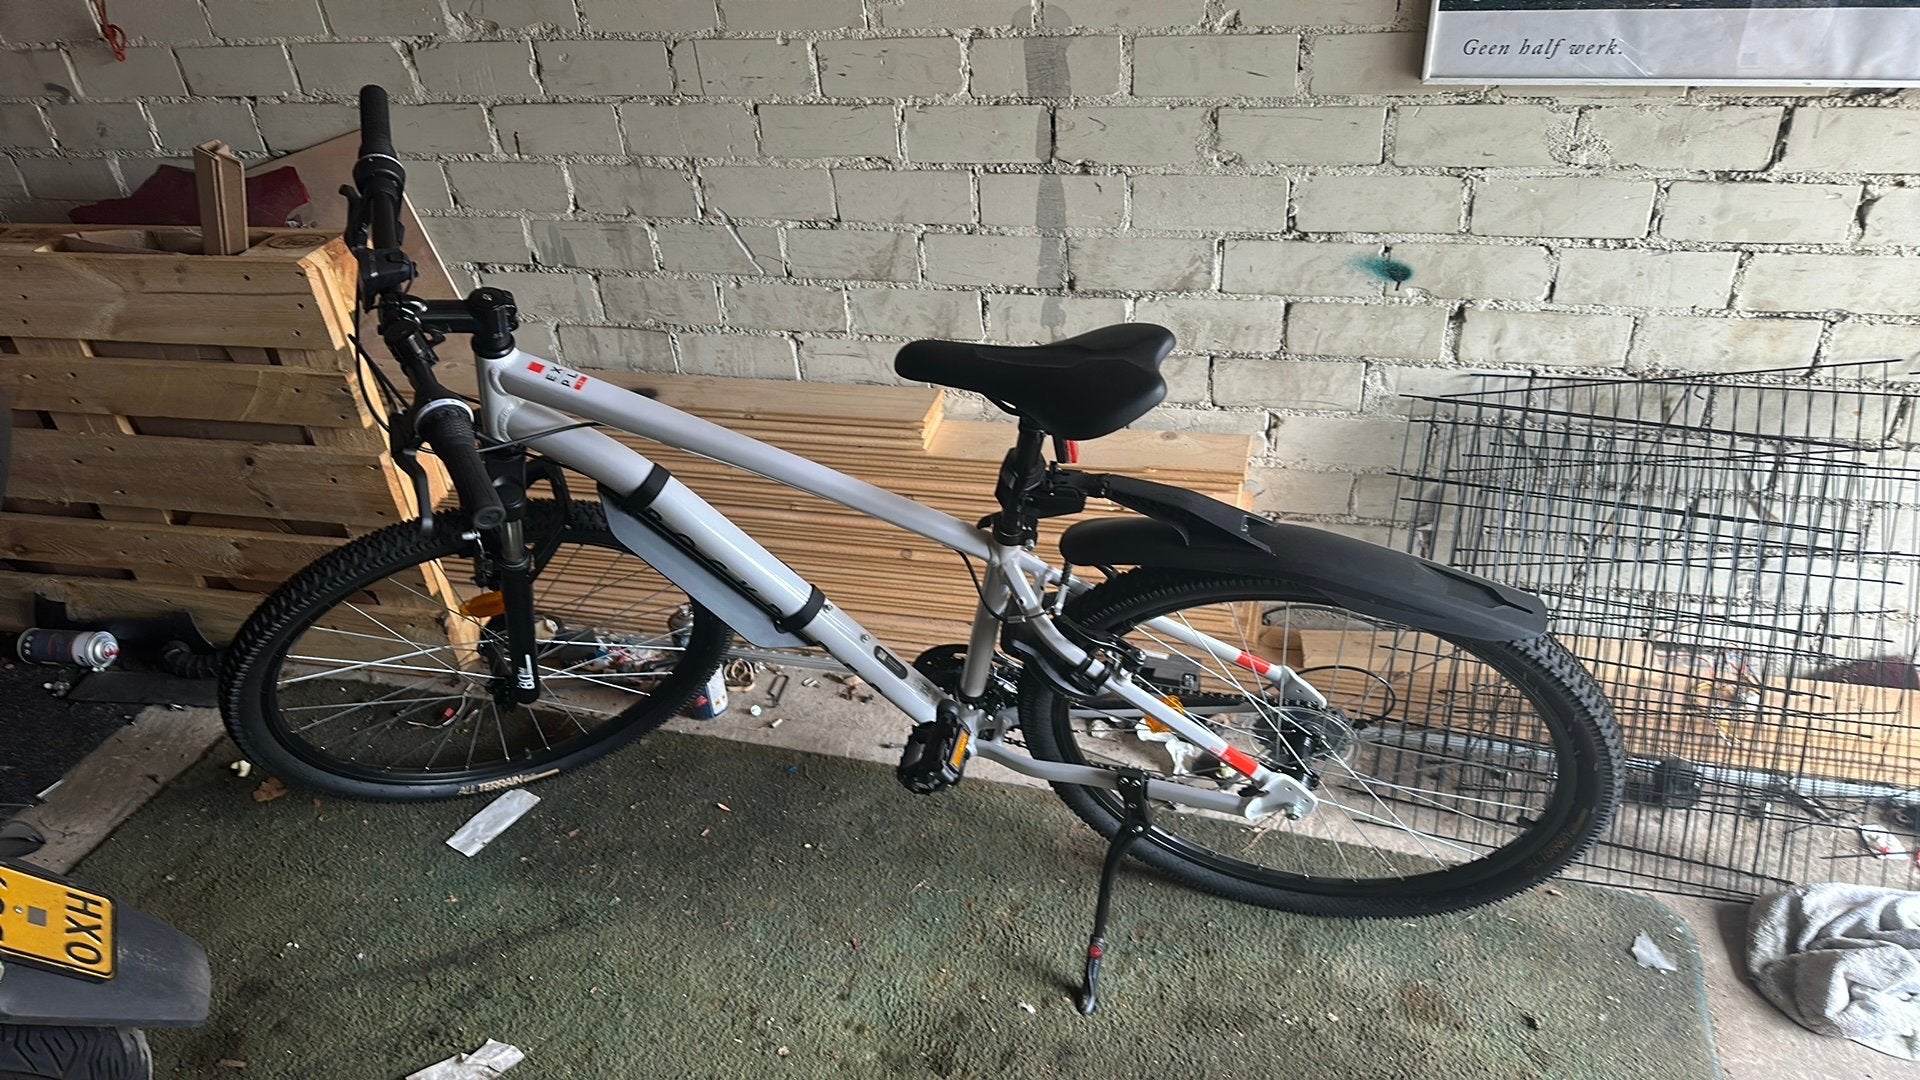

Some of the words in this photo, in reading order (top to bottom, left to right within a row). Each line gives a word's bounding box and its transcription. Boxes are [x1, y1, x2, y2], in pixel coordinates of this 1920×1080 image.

[1463, 38, 1510, 56] Geen
[1518, 38, 1567, 60] half
[1568, 38, 1623, 56] werk.
[545, 365, 563, 382] EX
[560, 373, 579, 388] PL
[478, 774, 524, 792] TERRAIN
[65, 891, 104, 965] HXO
